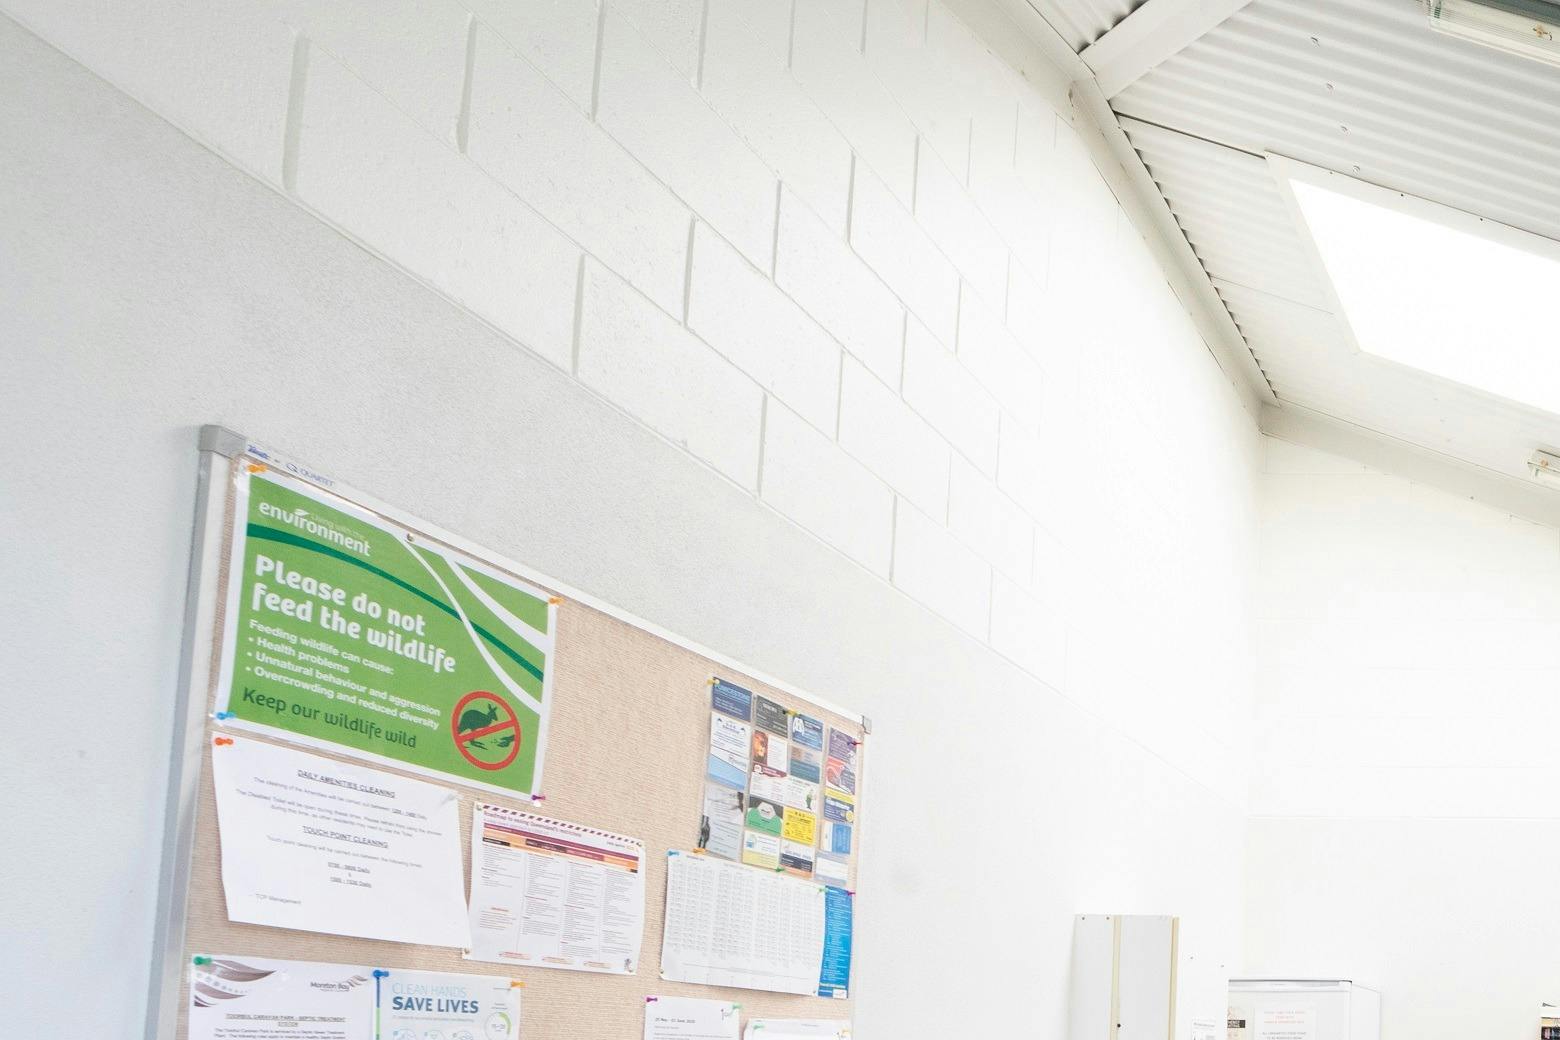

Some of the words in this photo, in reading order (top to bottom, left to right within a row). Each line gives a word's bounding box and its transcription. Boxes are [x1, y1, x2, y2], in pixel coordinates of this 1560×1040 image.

[259, 502, 371, 556] environment
[256, 554, 346, 606] Please
[352, 592, 382, 619] do
[387, 608, 426, 637] not
[249, 619, 298, 644] Feeding
[300, 637, 340, 656] wildlife
[340, 651, 361, 664] can
[362, 658, 394, 675] cause:
[252, 582, 313, 622] feed
[320, 605, 361, 639] the
[366, 627, 456, 673] wildlife
[257, 637, 296, 656] Health
[298, 651, 350, 673] problems
[254, 666, 334, 699] Overcrowding
[336, 692, 357, 704] and
[358, 699, 398, 717] reduced
[400, 711, 440, 730] diversity
[256, 651, 313, 676] Unnatural
[315, 669, 367, 693] behaviour
[369, 688, 387, 700] and
[388, 695, 440, 716] aggression
[243, 687, 286, 714] Keep
[291, 703, 320, 719] our
[324, 712, 382, 739] wildlife
[385, 730, 417, 748] wild
[392, 996, 433, 1012] SAVE
[437, 998, 479, 1014] LIVES
